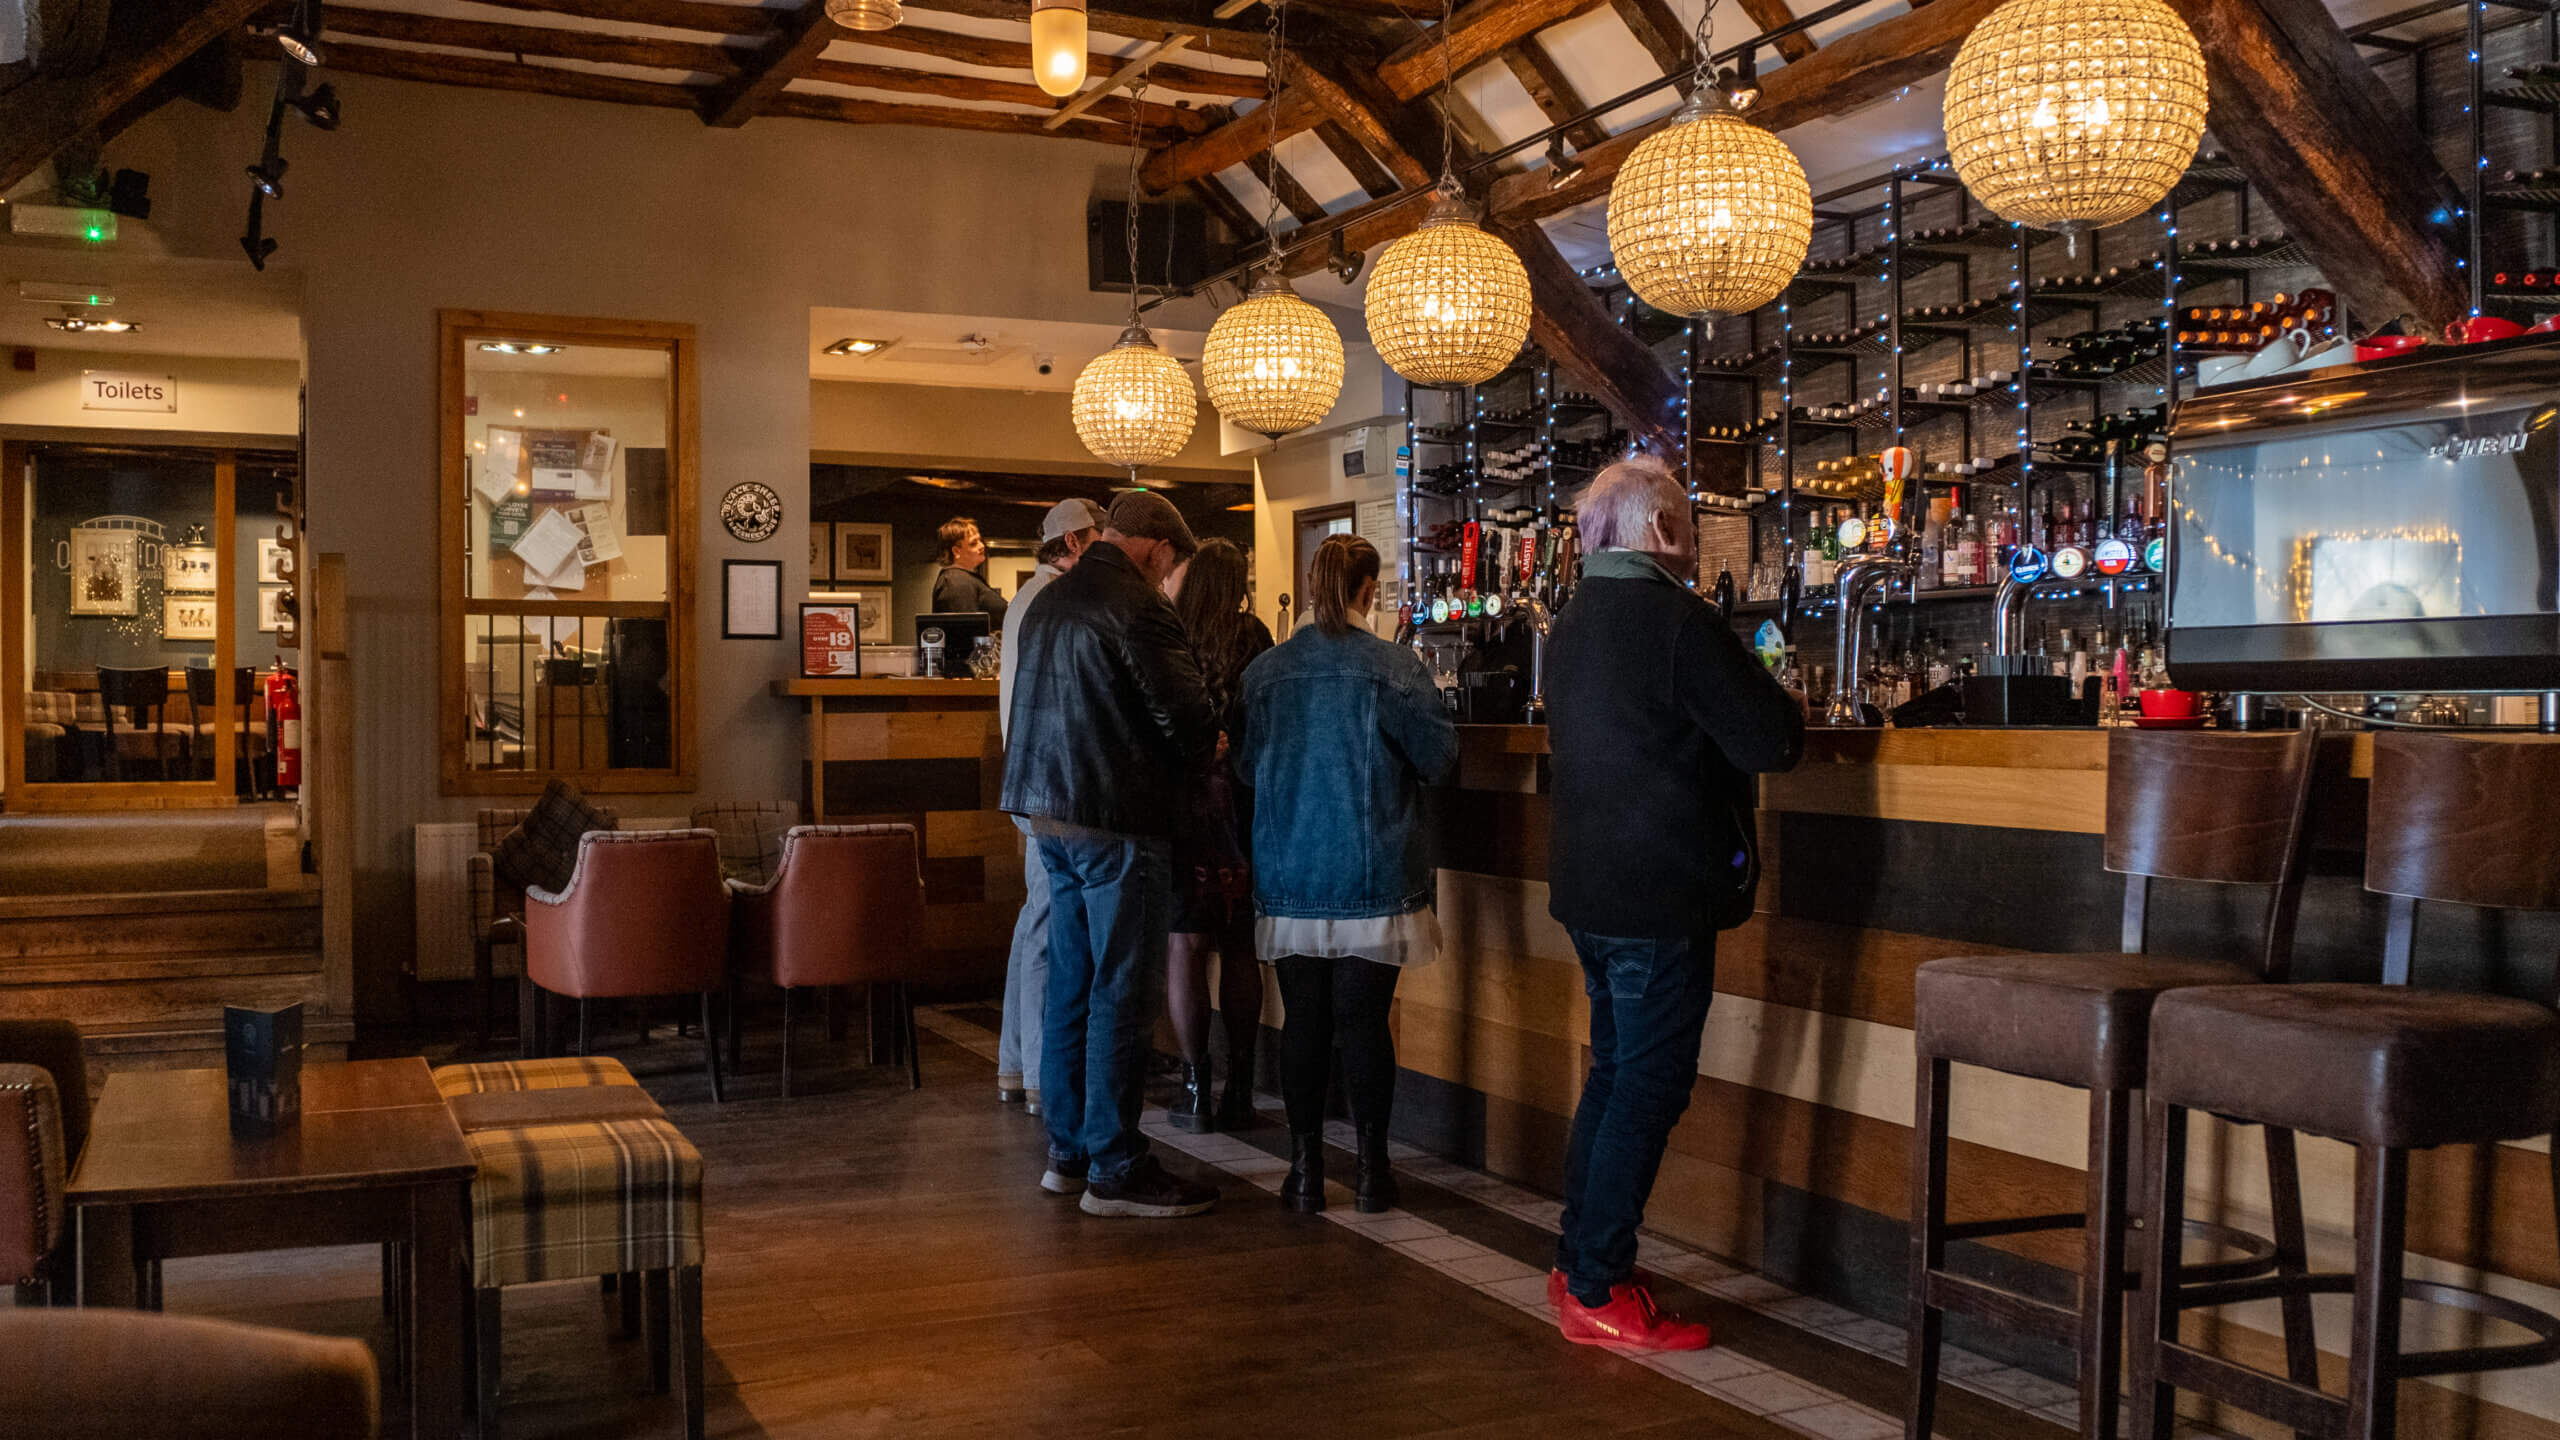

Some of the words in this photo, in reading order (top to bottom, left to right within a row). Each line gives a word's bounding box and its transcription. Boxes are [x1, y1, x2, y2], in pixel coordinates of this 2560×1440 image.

[92, 381, 163, 400] Toilets
[721, 484, 752, 513] BLACK
[754, 485, 780, 515] SHEEP
[1522, 539, 1533, 573] AMSTEL
[829, 631, 851, 647] 18
